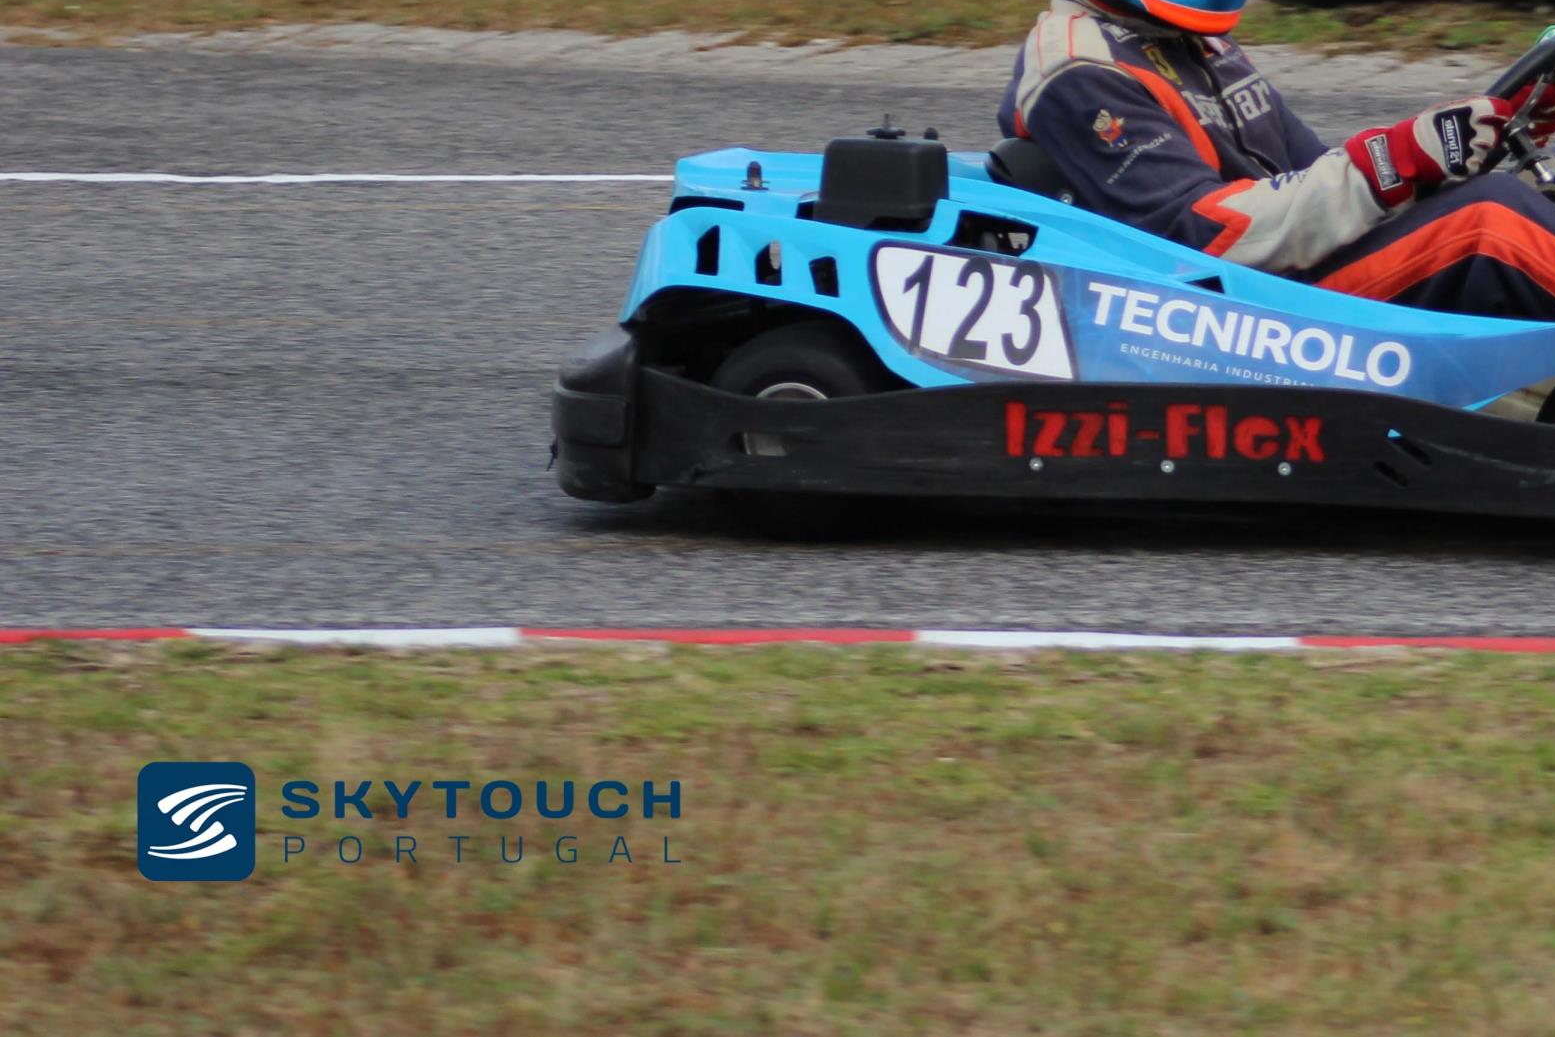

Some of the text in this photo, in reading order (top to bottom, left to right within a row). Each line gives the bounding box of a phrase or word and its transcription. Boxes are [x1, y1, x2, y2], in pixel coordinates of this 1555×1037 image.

[902, 255, 1046, 366] 123
[1088, 281, 1413, 388] TECNIROLO
[1119, 343, 1316, 387] ENGENHARIA INDUSTRI
[1004, 402, 1327, 462] Izzi-Flex
